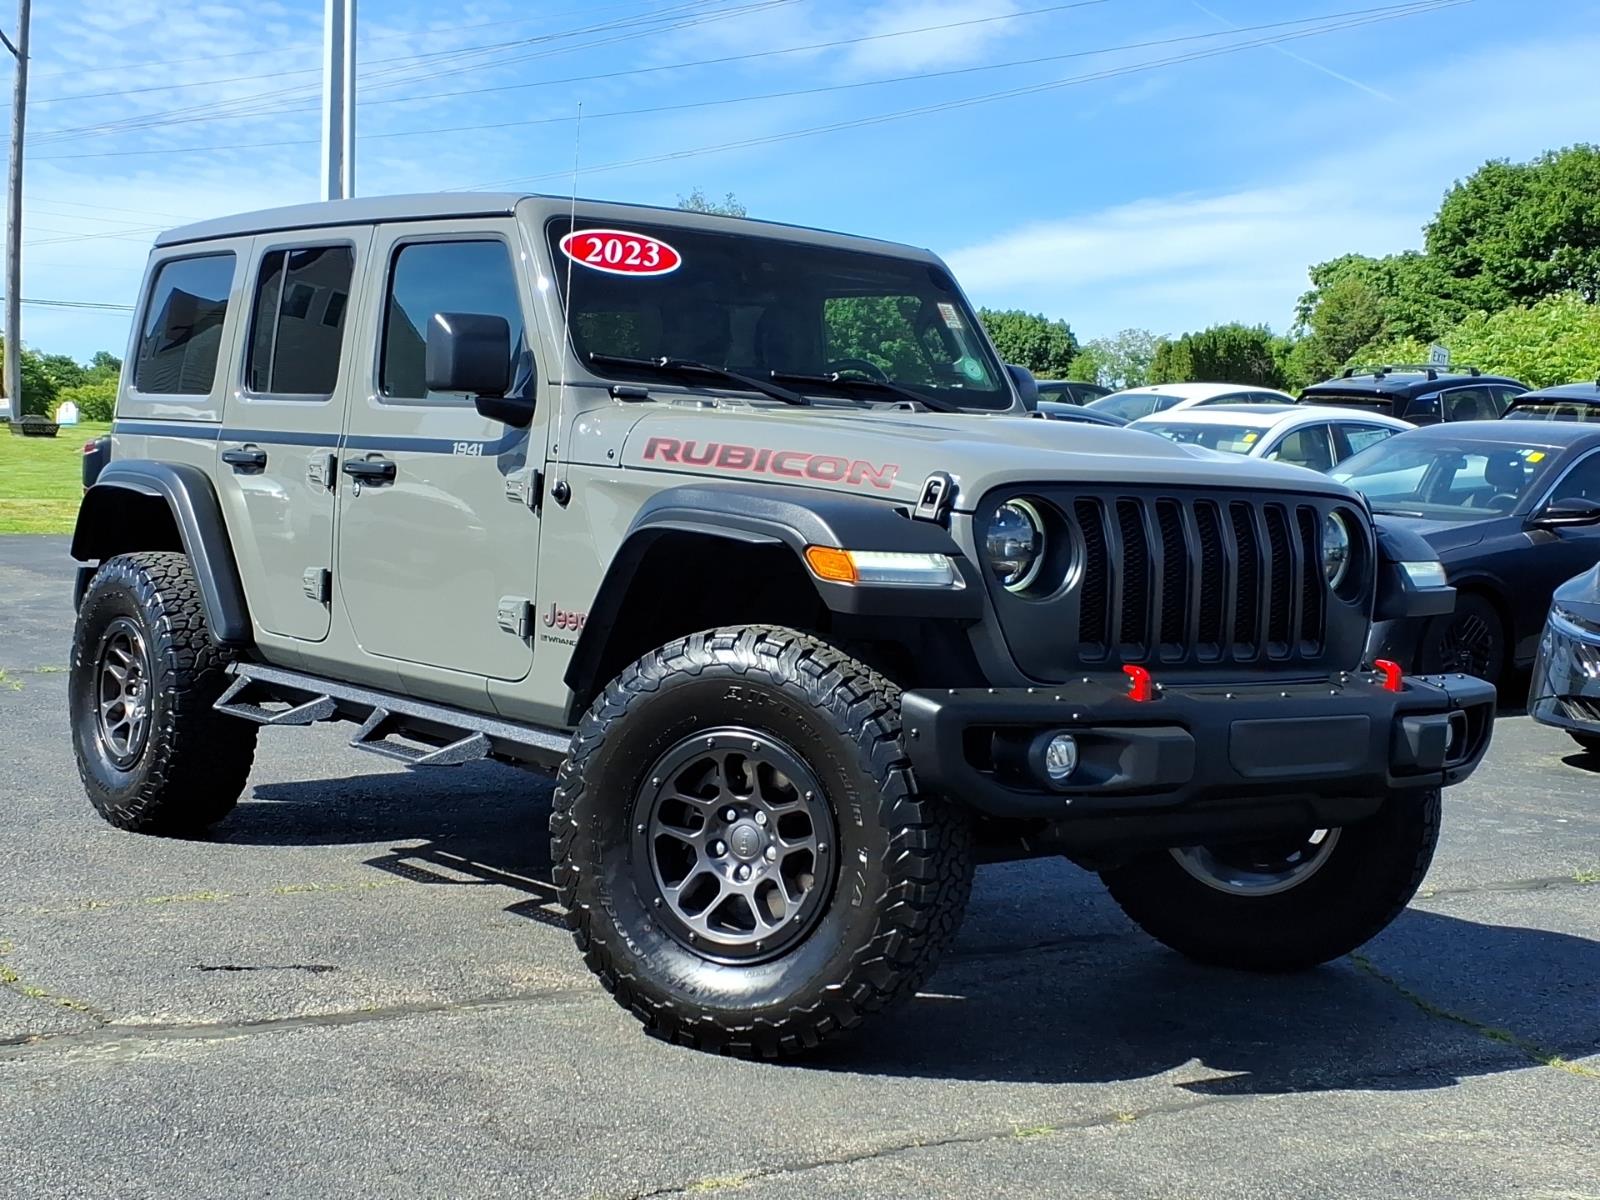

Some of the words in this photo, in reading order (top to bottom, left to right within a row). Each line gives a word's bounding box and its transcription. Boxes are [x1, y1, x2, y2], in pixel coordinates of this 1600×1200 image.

[585, 237, 660, 267] 2023
[453, 442, 484, 456] 1941
[643, 437, 899, 489] RUBICON
[548, 635, 577, 646] WRANG
